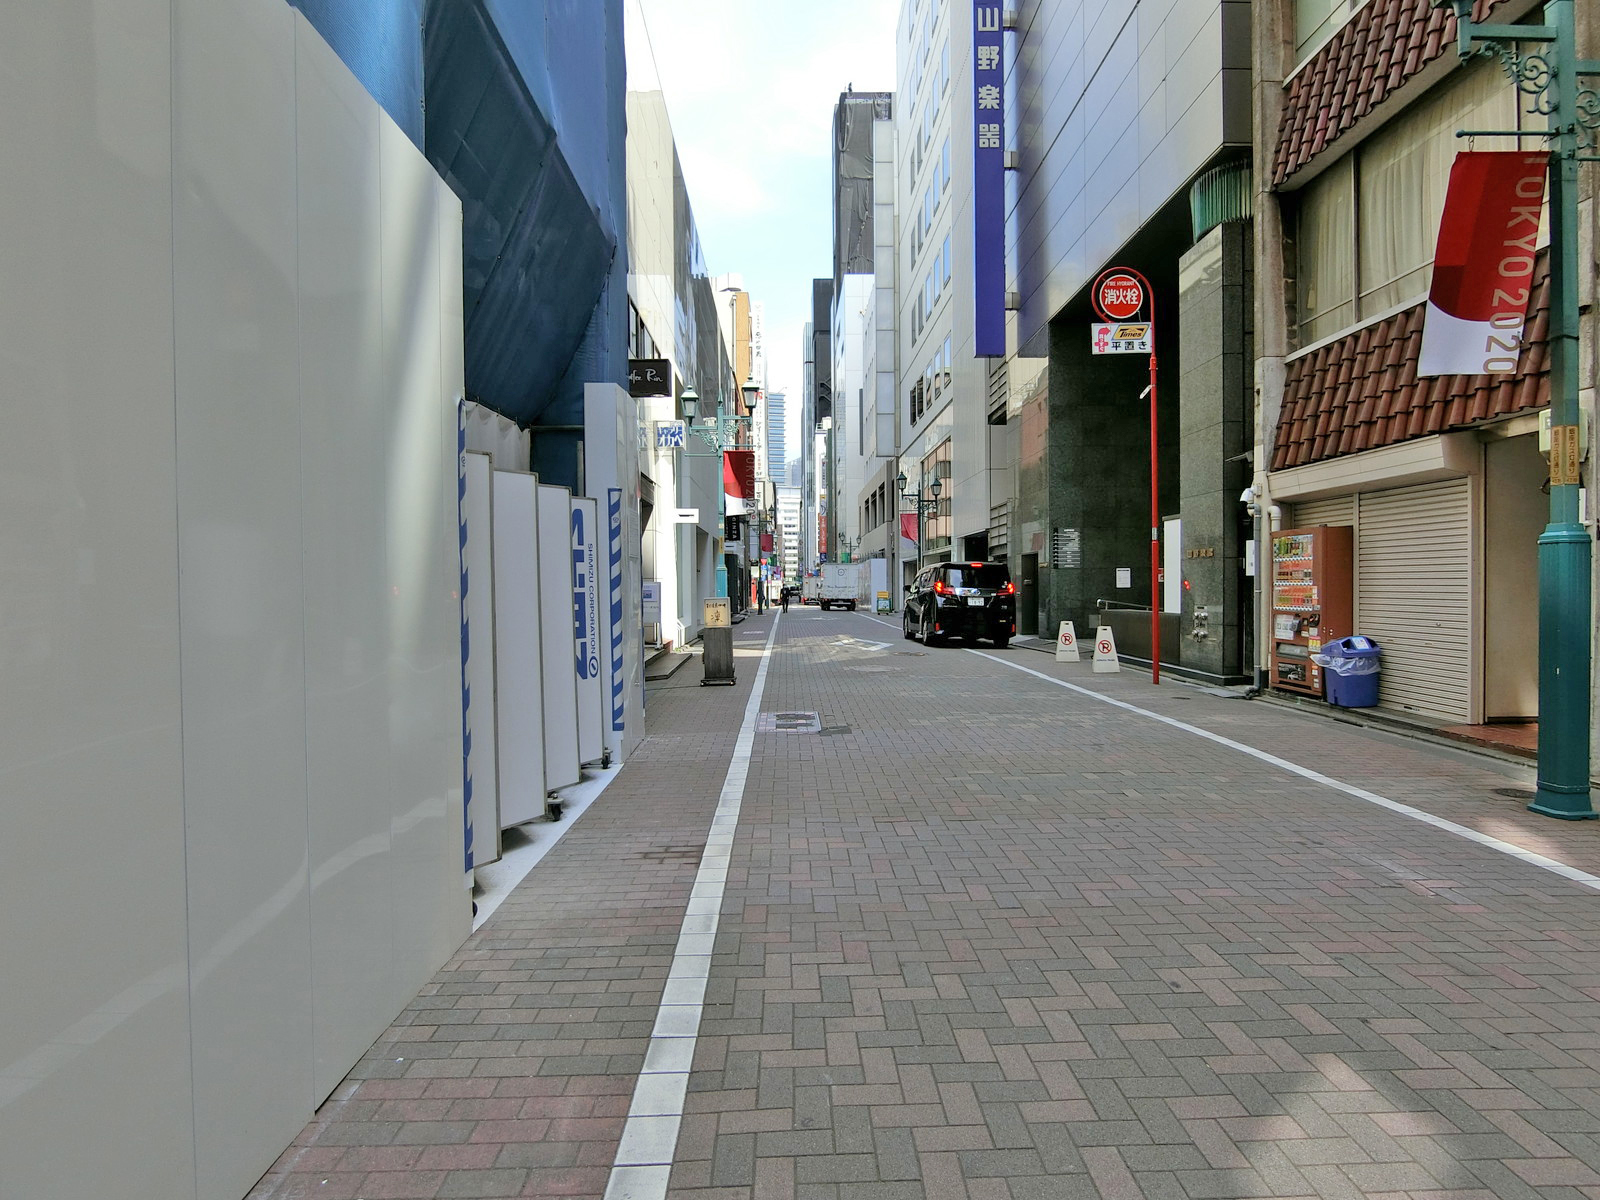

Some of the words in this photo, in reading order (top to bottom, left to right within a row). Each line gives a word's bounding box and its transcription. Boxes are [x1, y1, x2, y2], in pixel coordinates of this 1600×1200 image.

[977, 7, 1000, 148] 山野楽器
[1104, 288, 1139, 305] 消火栓
[1119, 328, 1145, 338] Times
[1482, 288, 1530, 375] 2020
[1111, 341, 1147, 351] 平置き
[645, 368, 664, 382] Rin
[657, 434, 684, 447] オカベ
[588, 585, 597, 654] CORPORATION
